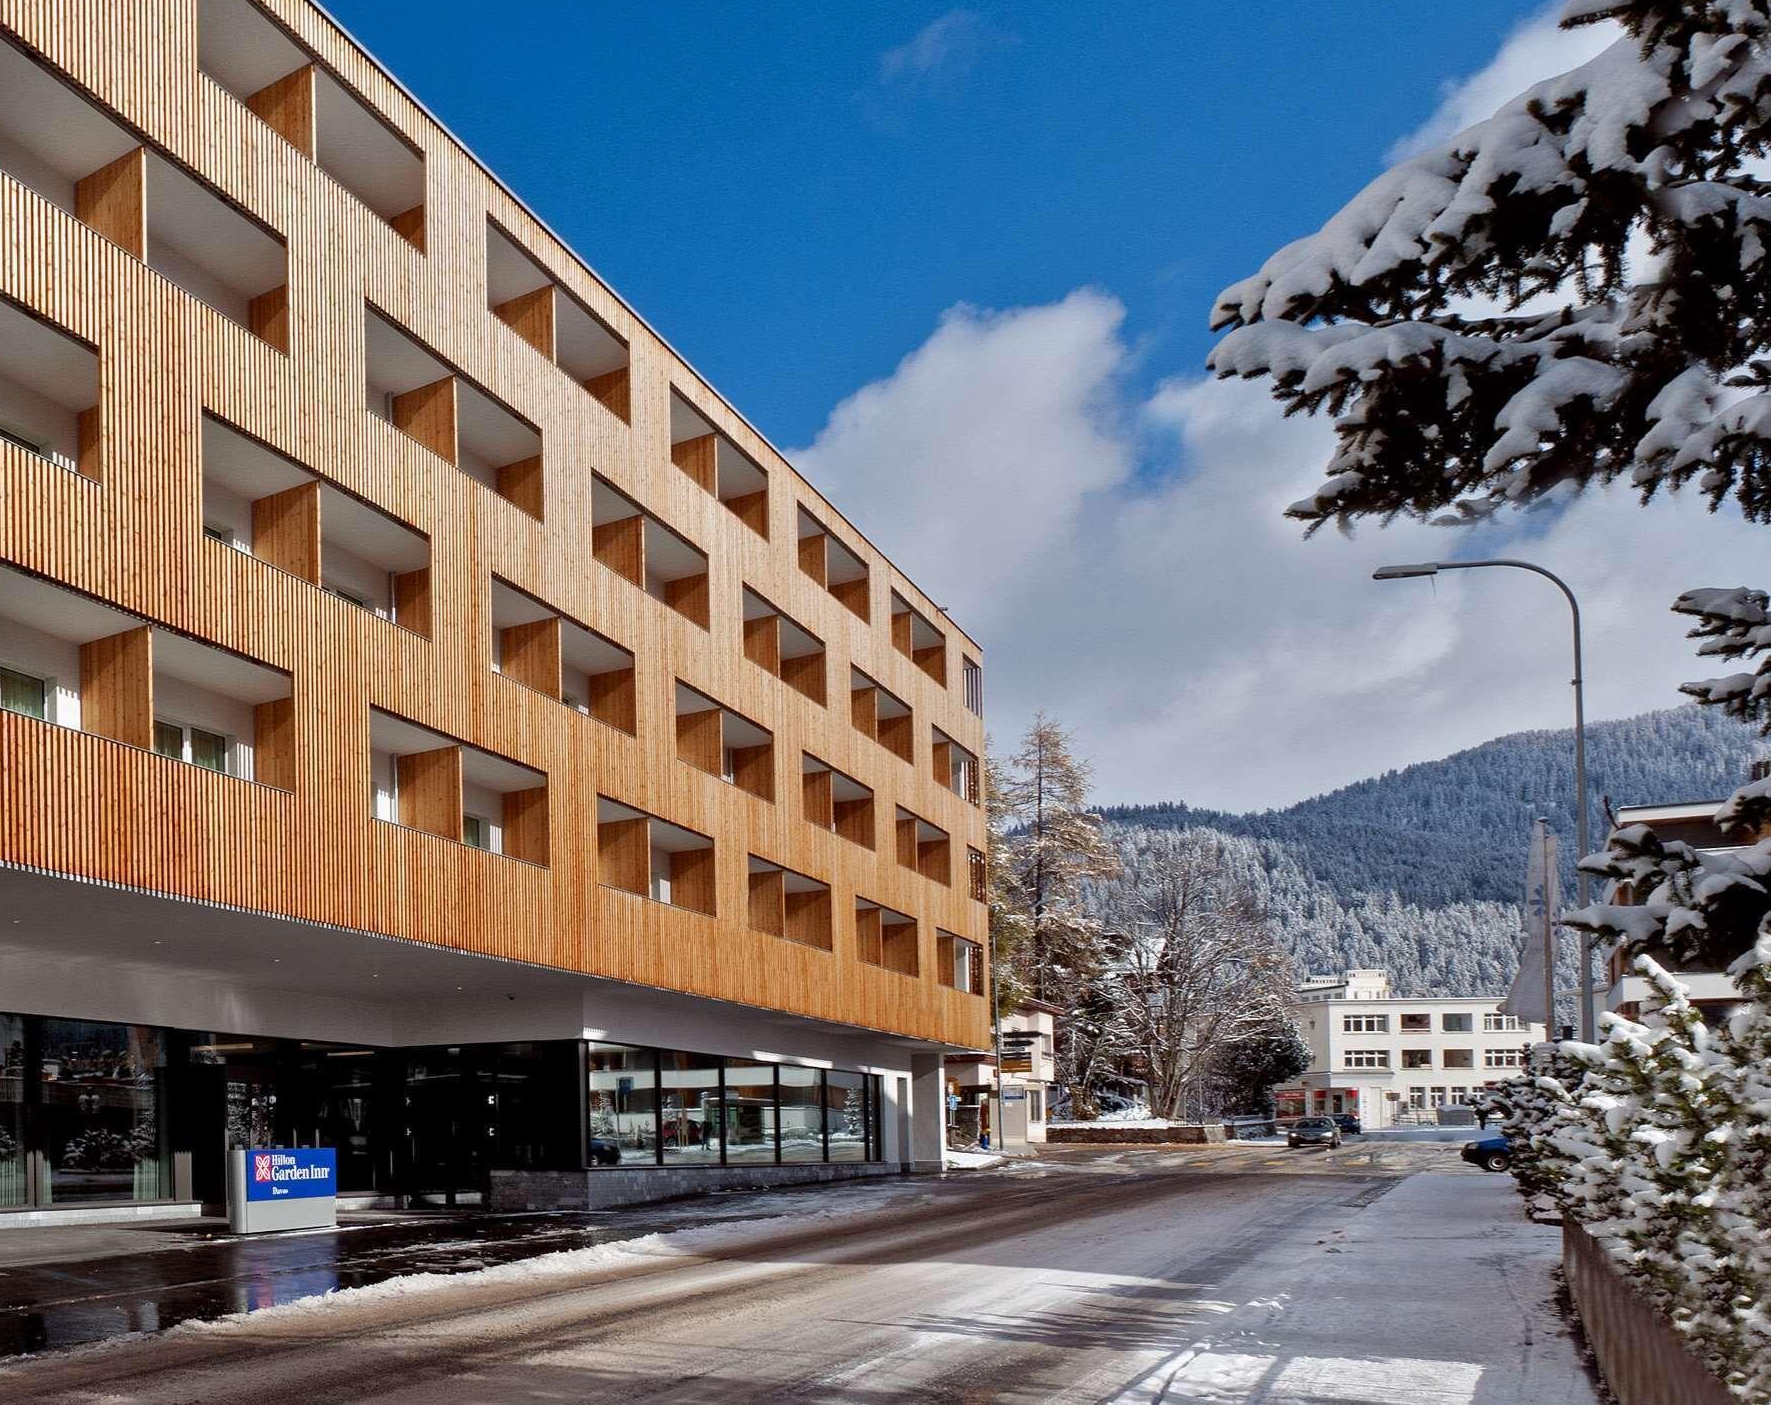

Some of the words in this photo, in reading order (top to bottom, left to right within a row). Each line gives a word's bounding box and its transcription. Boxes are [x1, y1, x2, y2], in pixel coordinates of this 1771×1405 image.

[272, 1155, 296, 1166] Hilton
[272, 1165, 309, 1181] Garden
[310, 1165, 329, 1179] Inn
